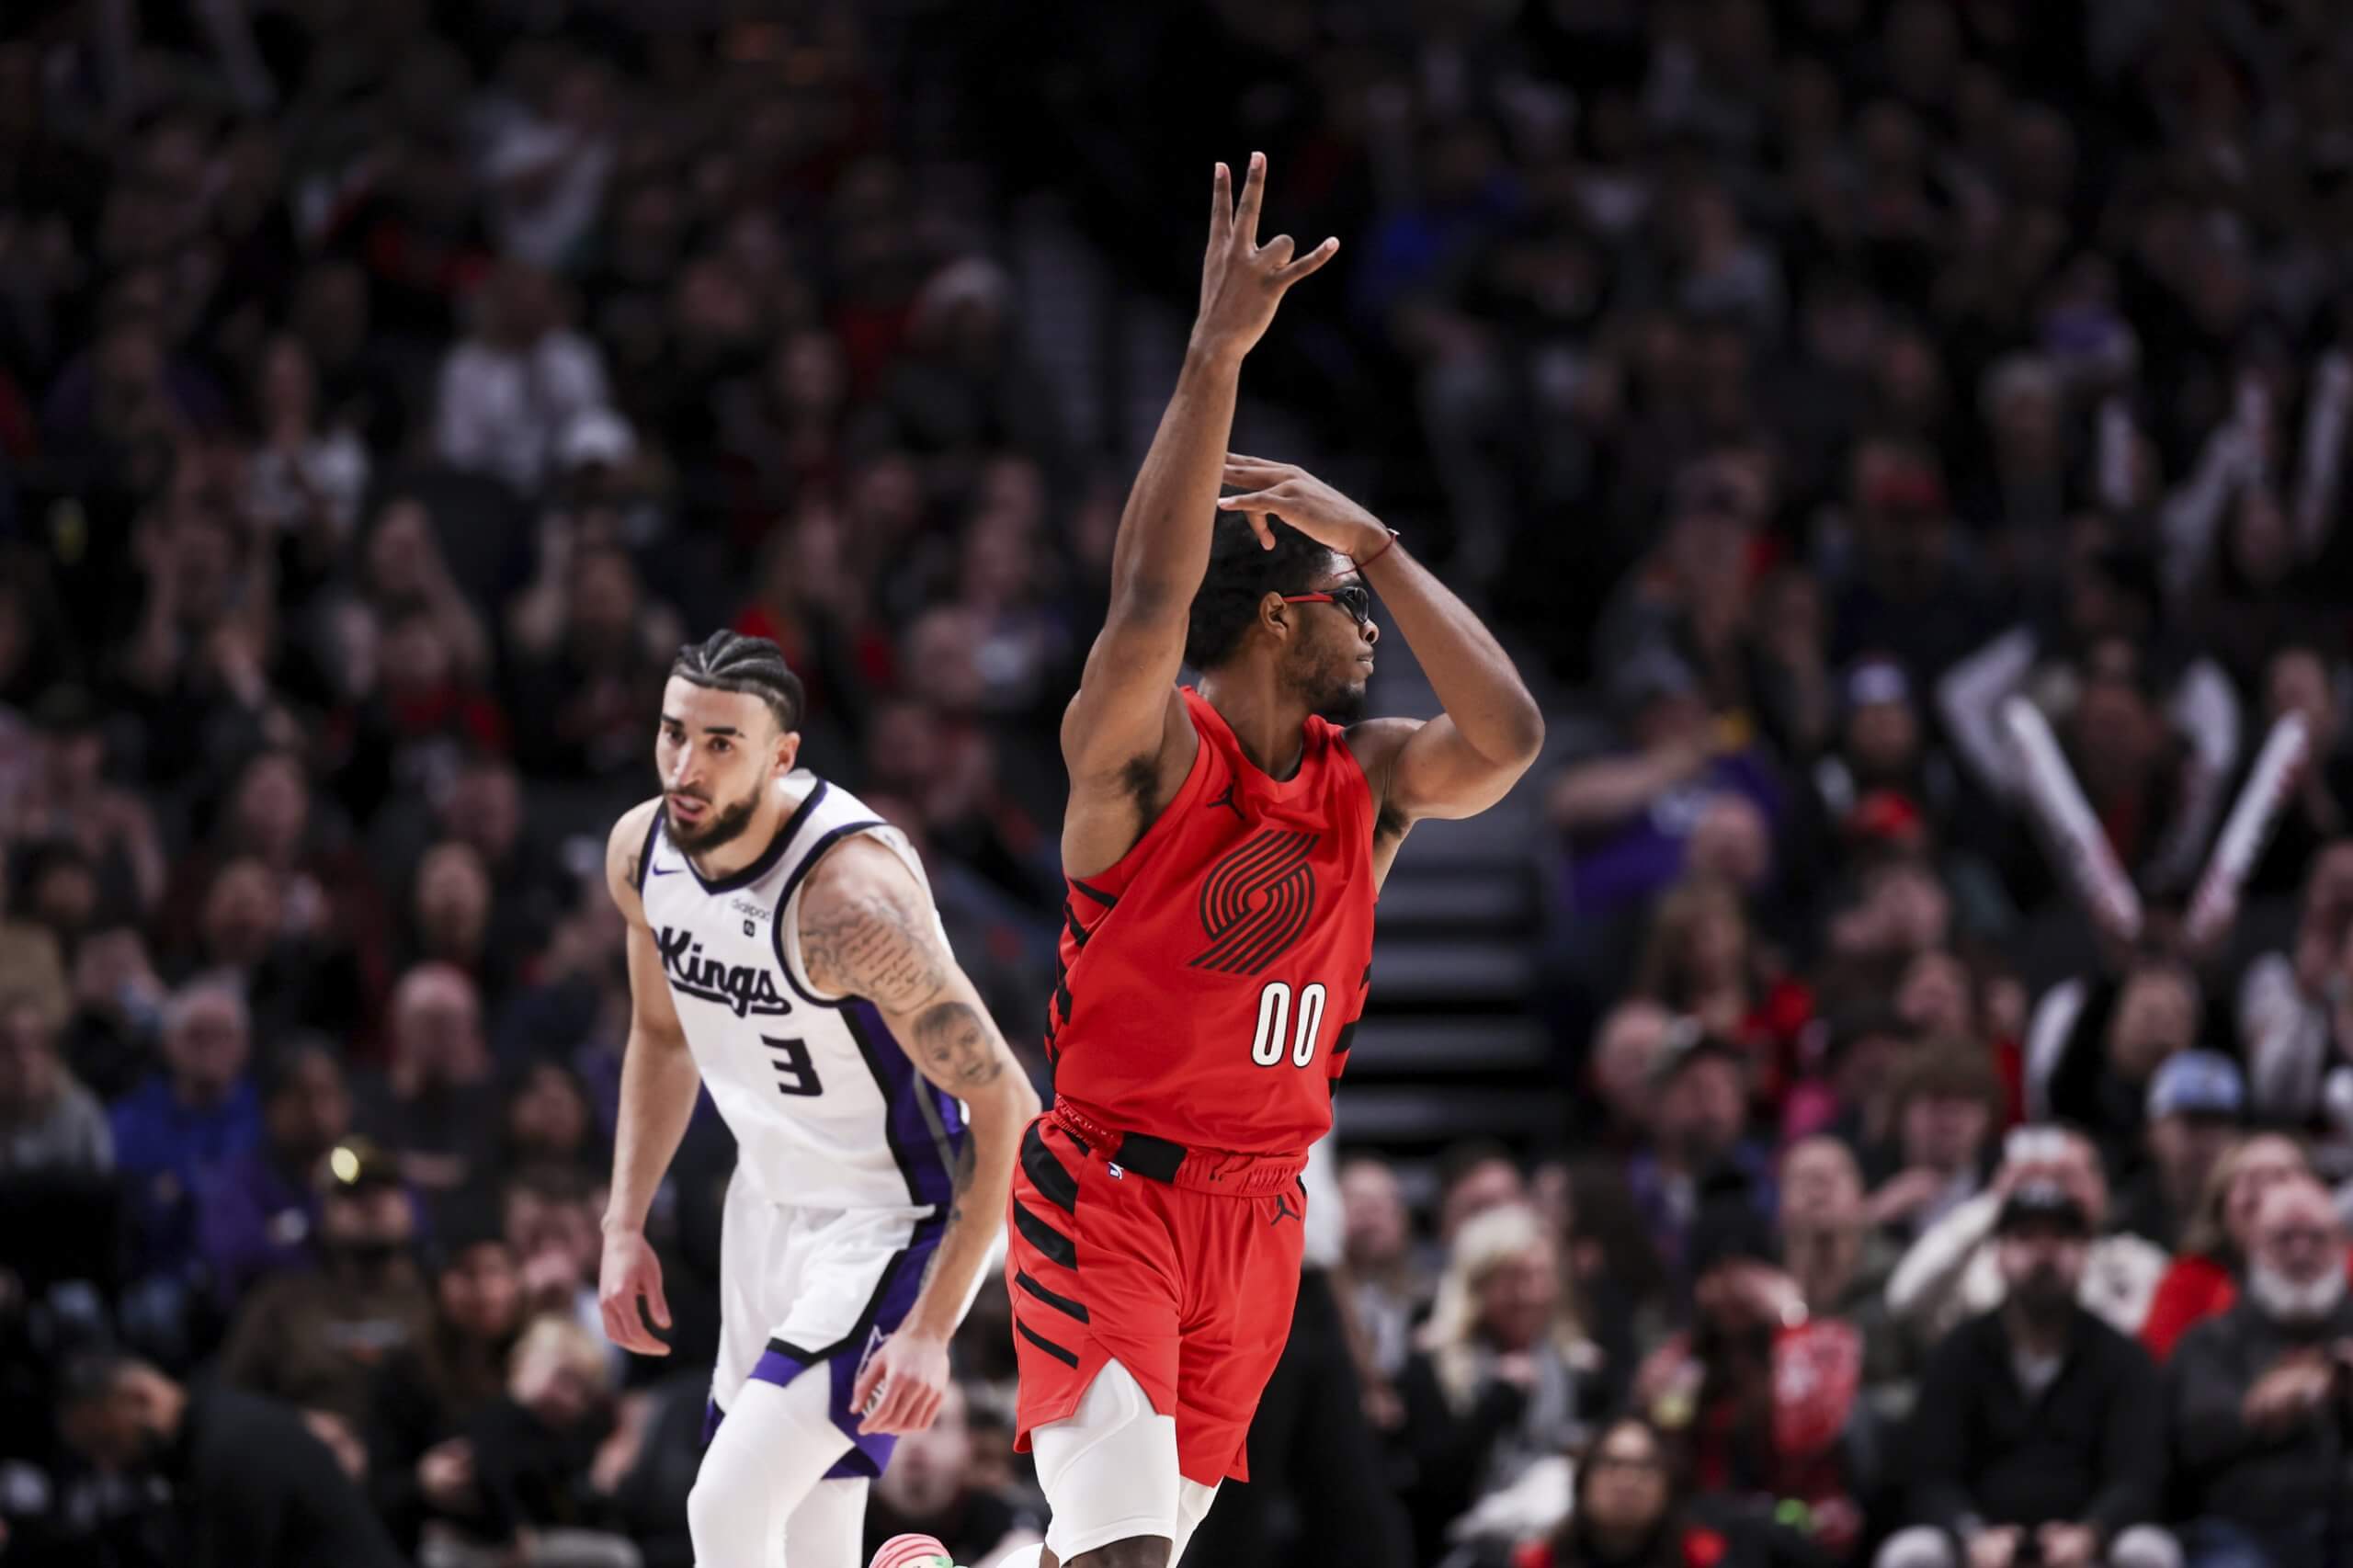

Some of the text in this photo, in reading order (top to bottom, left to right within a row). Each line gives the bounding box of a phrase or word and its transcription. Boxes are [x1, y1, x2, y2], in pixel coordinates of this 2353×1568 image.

[661, 926, 792, 1019] Kings
[760, 1032, 823, 1096] 3
[1251, 981, 1326, 1068] 00
